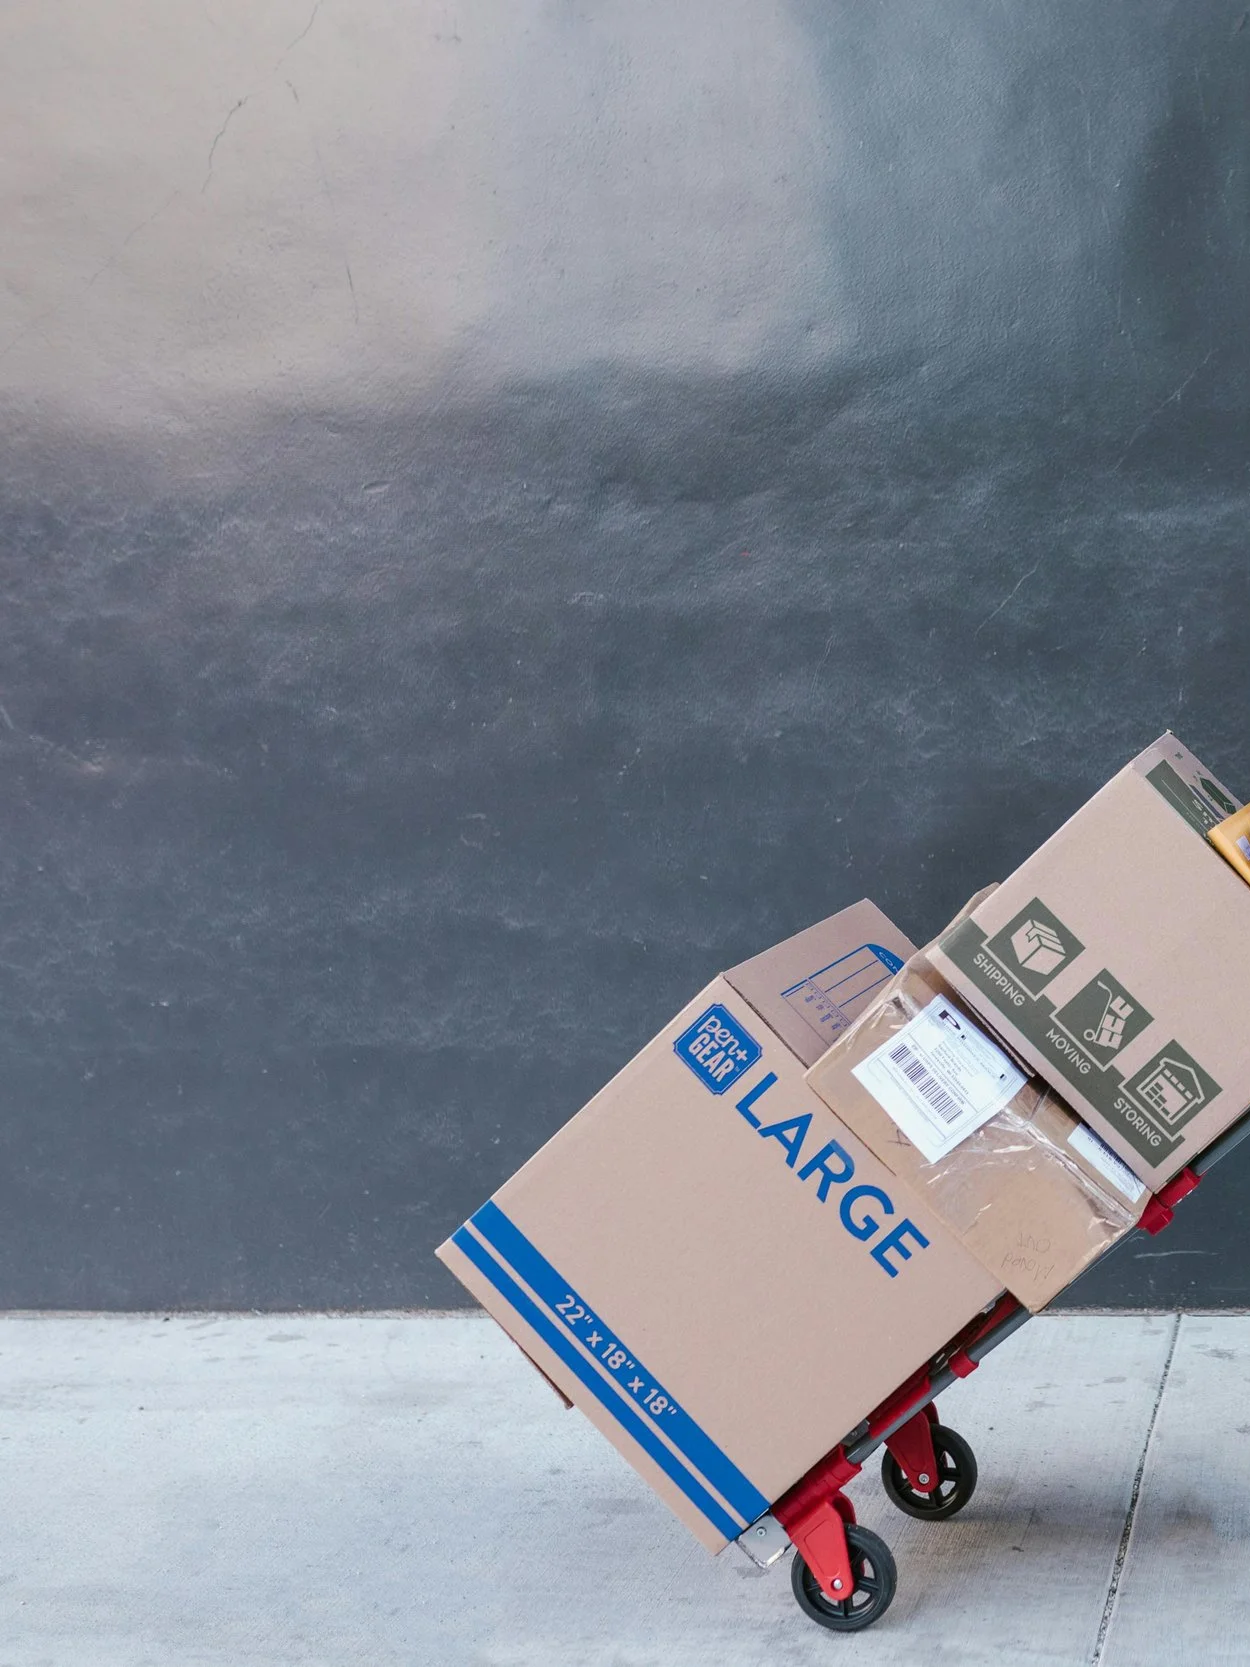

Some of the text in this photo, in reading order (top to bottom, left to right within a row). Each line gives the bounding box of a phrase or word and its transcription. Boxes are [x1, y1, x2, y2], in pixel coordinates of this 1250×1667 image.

[973, 953, 1025, 1006] SHIPPING
[688, 1033, 735, 1082] GEAR
[1046, 1028, 1091, 1075] MOVING
[1114, 1098, 1162, 1147] STORING
[735, 1071, 930, 1278] LARGE
[555, 1294, 677, 1416] 22" x 18" x 18"
